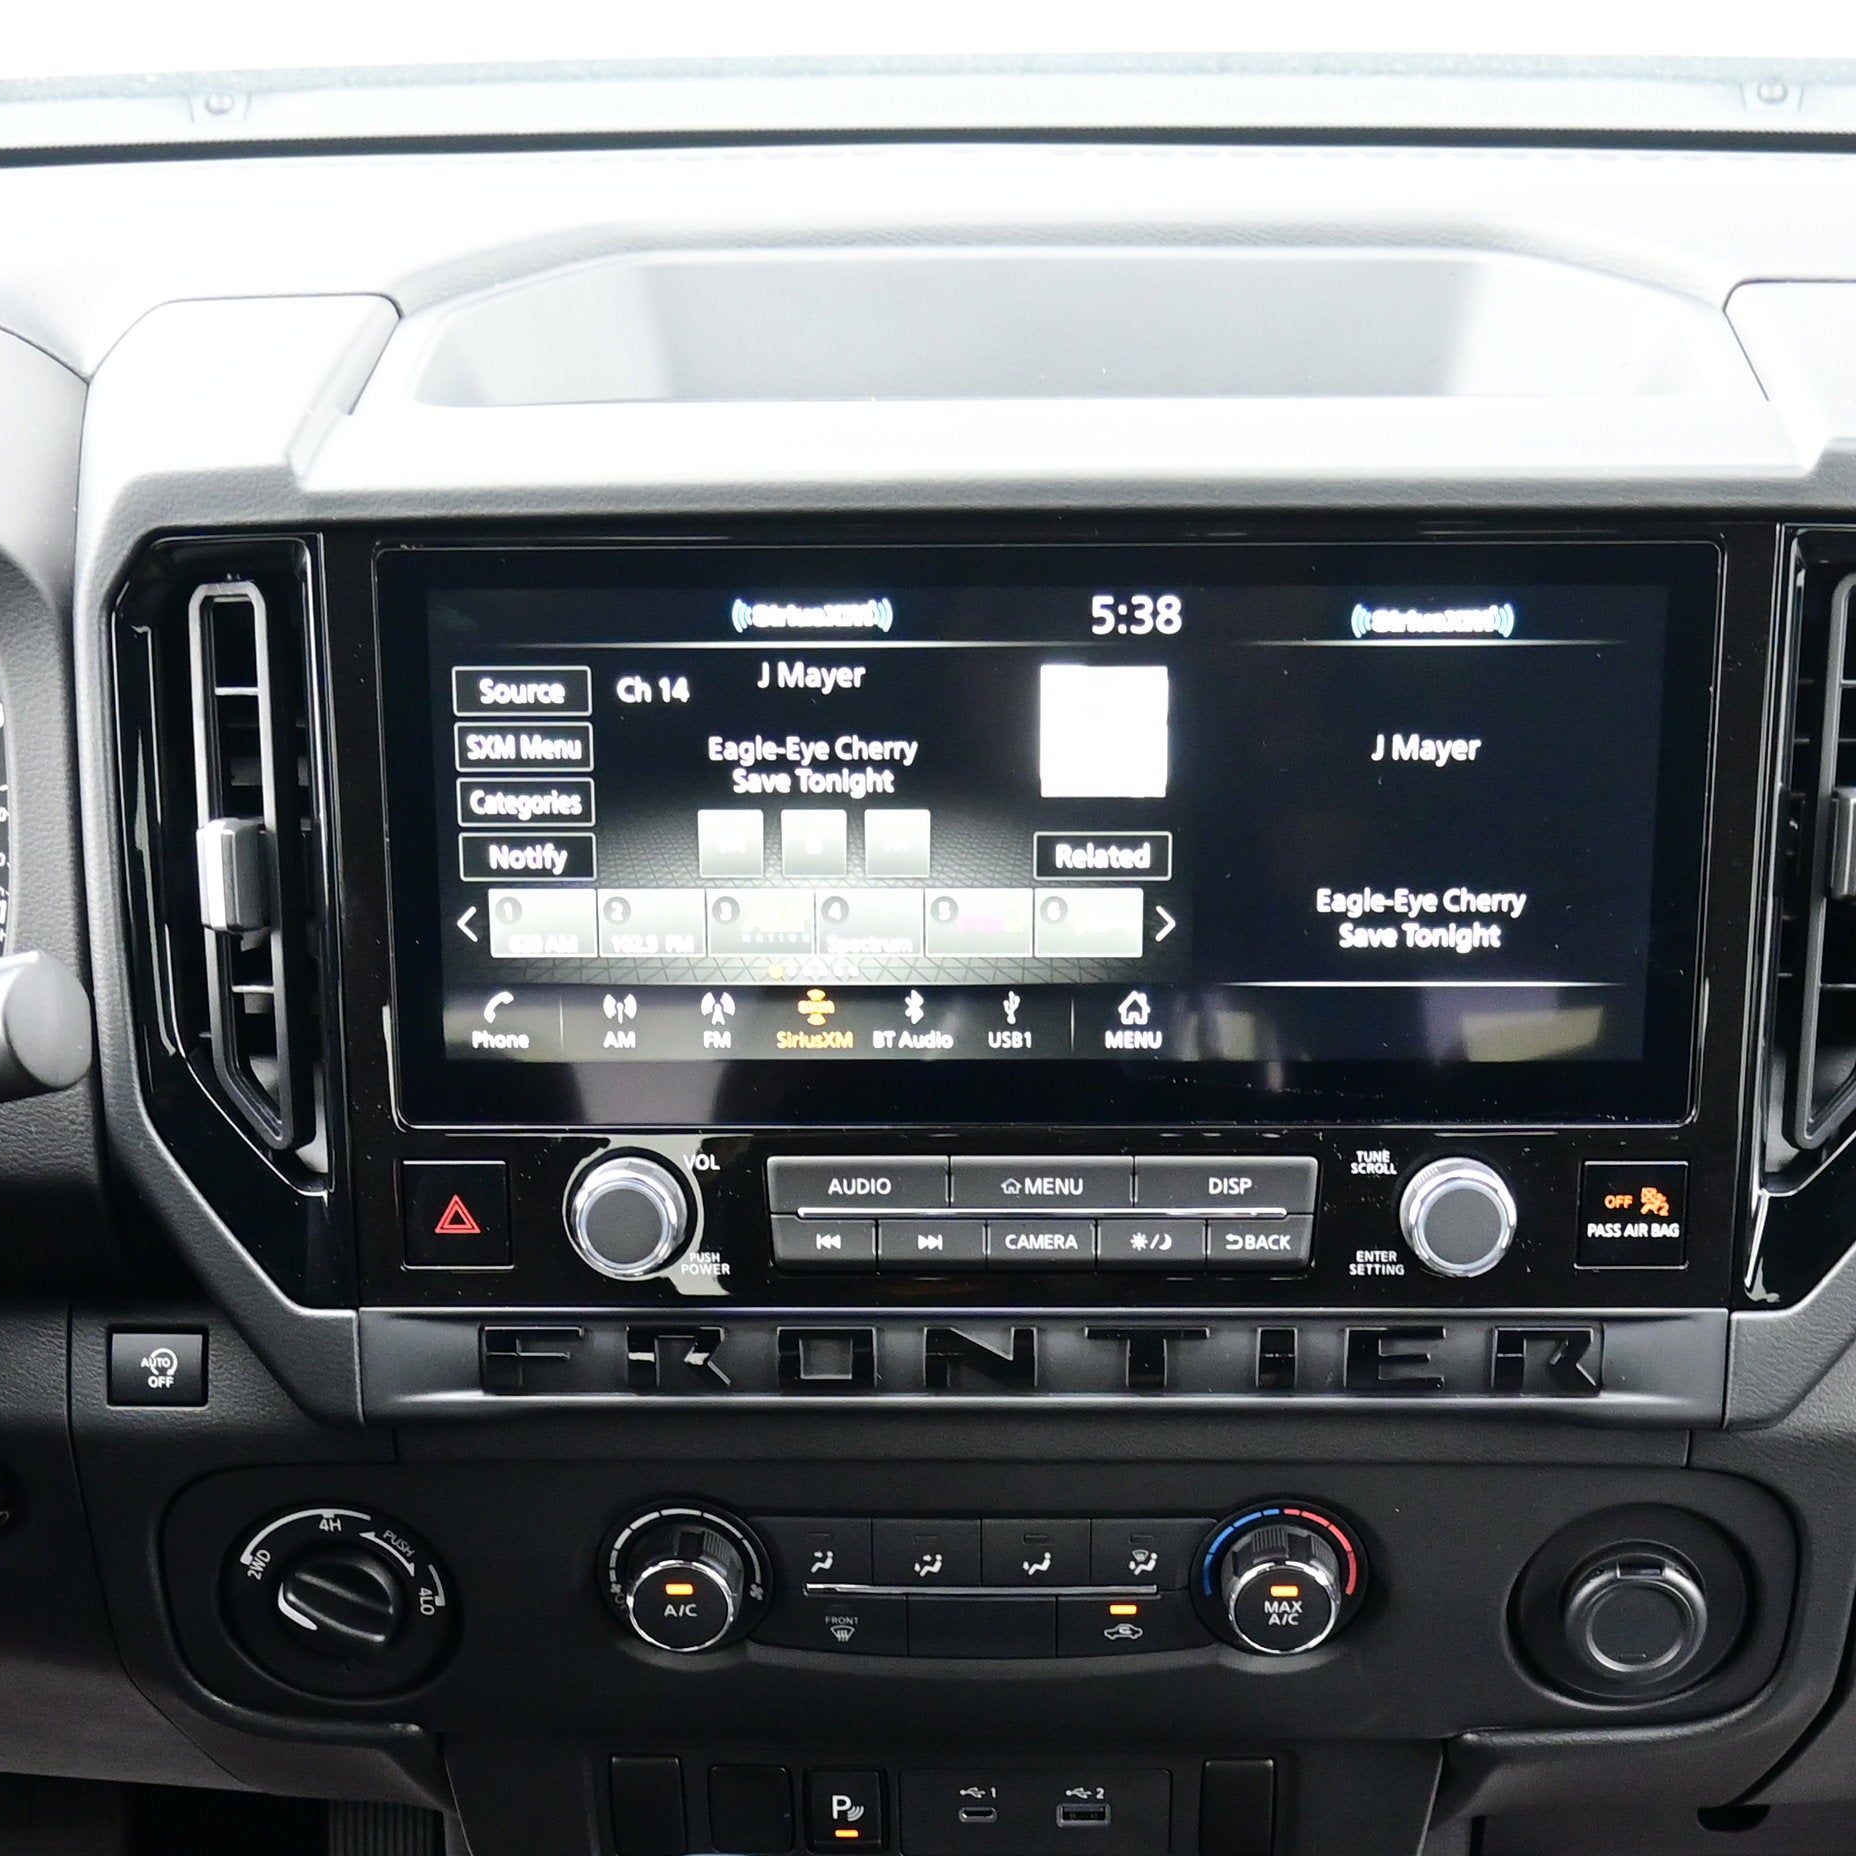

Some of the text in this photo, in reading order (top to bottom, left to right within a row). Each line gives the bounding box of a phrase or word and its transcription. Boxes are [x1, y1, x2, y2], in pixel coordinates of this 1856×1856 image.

[1091, 595, 1182, 635] 5:38
[758, 662, 865, 695] J Mayer
[480, 678, 565, 705] Source
[617, 677, 690, 704] Ch 14
[466, 734, 582, 760] SXM Menu
[708, 736, 918, 766] Eagle-Eye Cherry
[1372, 735, 1481, 767] J Mayer
[733, 768, 895, 798] Save Tonight
[469, 790, 582, 819] Categories
[489, 843, 567, 873] Notify
[1055, 842, 1151, 869] Related
[1316, 888, 1527, 919] Eagle-Eye Cherry
[827, 932, 913, 956] Spectrum
[1339, 922, 1501, 952] Save Tonight
[472, 1030, 530, 1049] Phone
[603, 1030, 636, 1049] AM
[703, 1030, 731, 1049] FM
[776, 1030, 854, 1049] SiriusXM
[873, 1030, 954, 1049] BT Audio
[988, 1030, 1032, 1049] USB1
[1105, 1030, 1162, 1049] MENU
[682, 1154, 720, 1172] VOL
[1356, 1151, 1391, 1163] TUNE
[1350, 1163, 1397, 1175] SCROLL
[828, 1178, 892, 1196] AUDIO
[1024, 1178, 1084, 1196] MENU
[1208, 1178, 1253, 1196] DISP
[1604, 1194, 1634, 1209] OFF
[1587, 1223, 1681, 1239] PASS AIR BAG
[1005, 1234, 1079, 1251] CAMERA
[1244, 1234, 1292, 1251] BACK
[689, 1252, 721, 1264] PUSH
[1355, 1251, 1398, 1263] ENTER
[680, 1263, 731, 1276] POWER
[1349, 1263, 1405, 1276] SETTING
[140, 1357, 172, 1369] AUTO
[480, 1326, 1603, 1392] FRONTIER
[148, 1376, 174, 1389] OFF
[319, 1517, 342, 1532] 4H
[381, 1529, 416, 1558] PUSH
[247, 1548, 272, 1580] 2WD
[663, 1603, 698, 1618] A/C
[1264, 1601, 1304, 1616] MAX
[824, 1616, 860, 1627] FRONT
[1268, 1613, 1300, 1627] A/C
[990, 1786, 997, 1799] 1
[1095, 1786, 1105, 1799] 2
[831, 1794, 852, 1821] P
